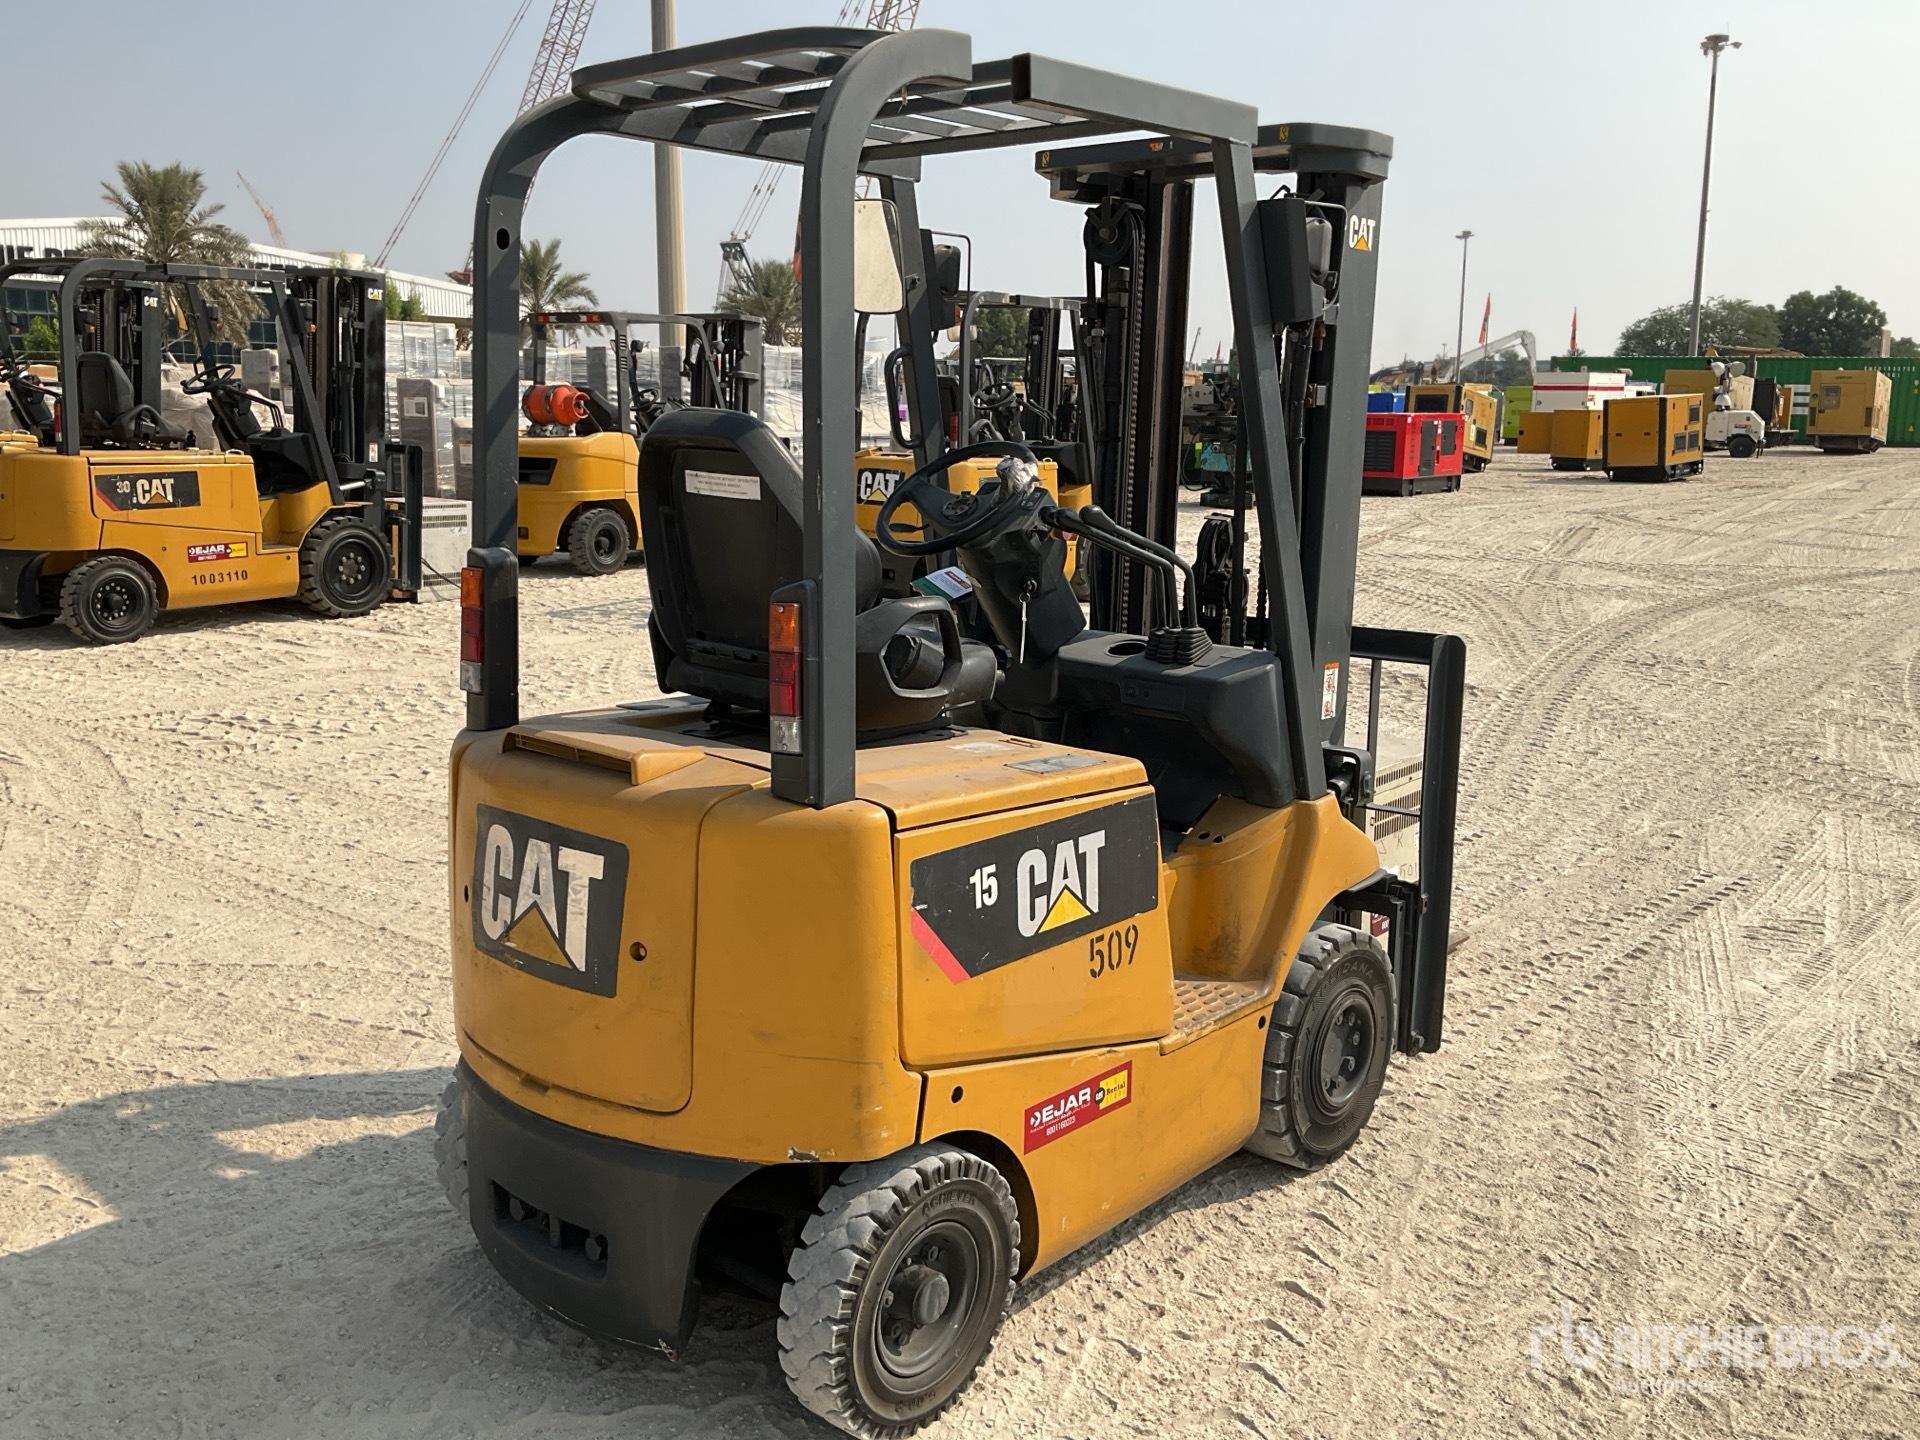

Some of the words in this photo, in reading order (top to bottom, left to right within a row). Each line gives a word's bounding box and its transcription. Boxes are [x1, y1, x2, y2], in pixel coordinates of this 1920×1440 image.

[1349, 214, 1376, 252] CAT
[144, 296, 159, 308] CAT
[367, 287, 384, 301] CAT
[116, 480, 131, 494] 30
[136, 478, 175, 505] CAT
[860, 471, 900, 500] CAT
[195, 544, 225, 554] EJAR
[192, 569, 248, 585] 1003110
[969, 864, 998, 910] 15
[1016, 829, 1106, 938] CAT
[481, 823, 605, 973] CAT
[1089, 923, 1140, 979] 509
[1106, 1080, 1126, 1097] Rental
[1042, 1087, 1091, 1124] EJAR
